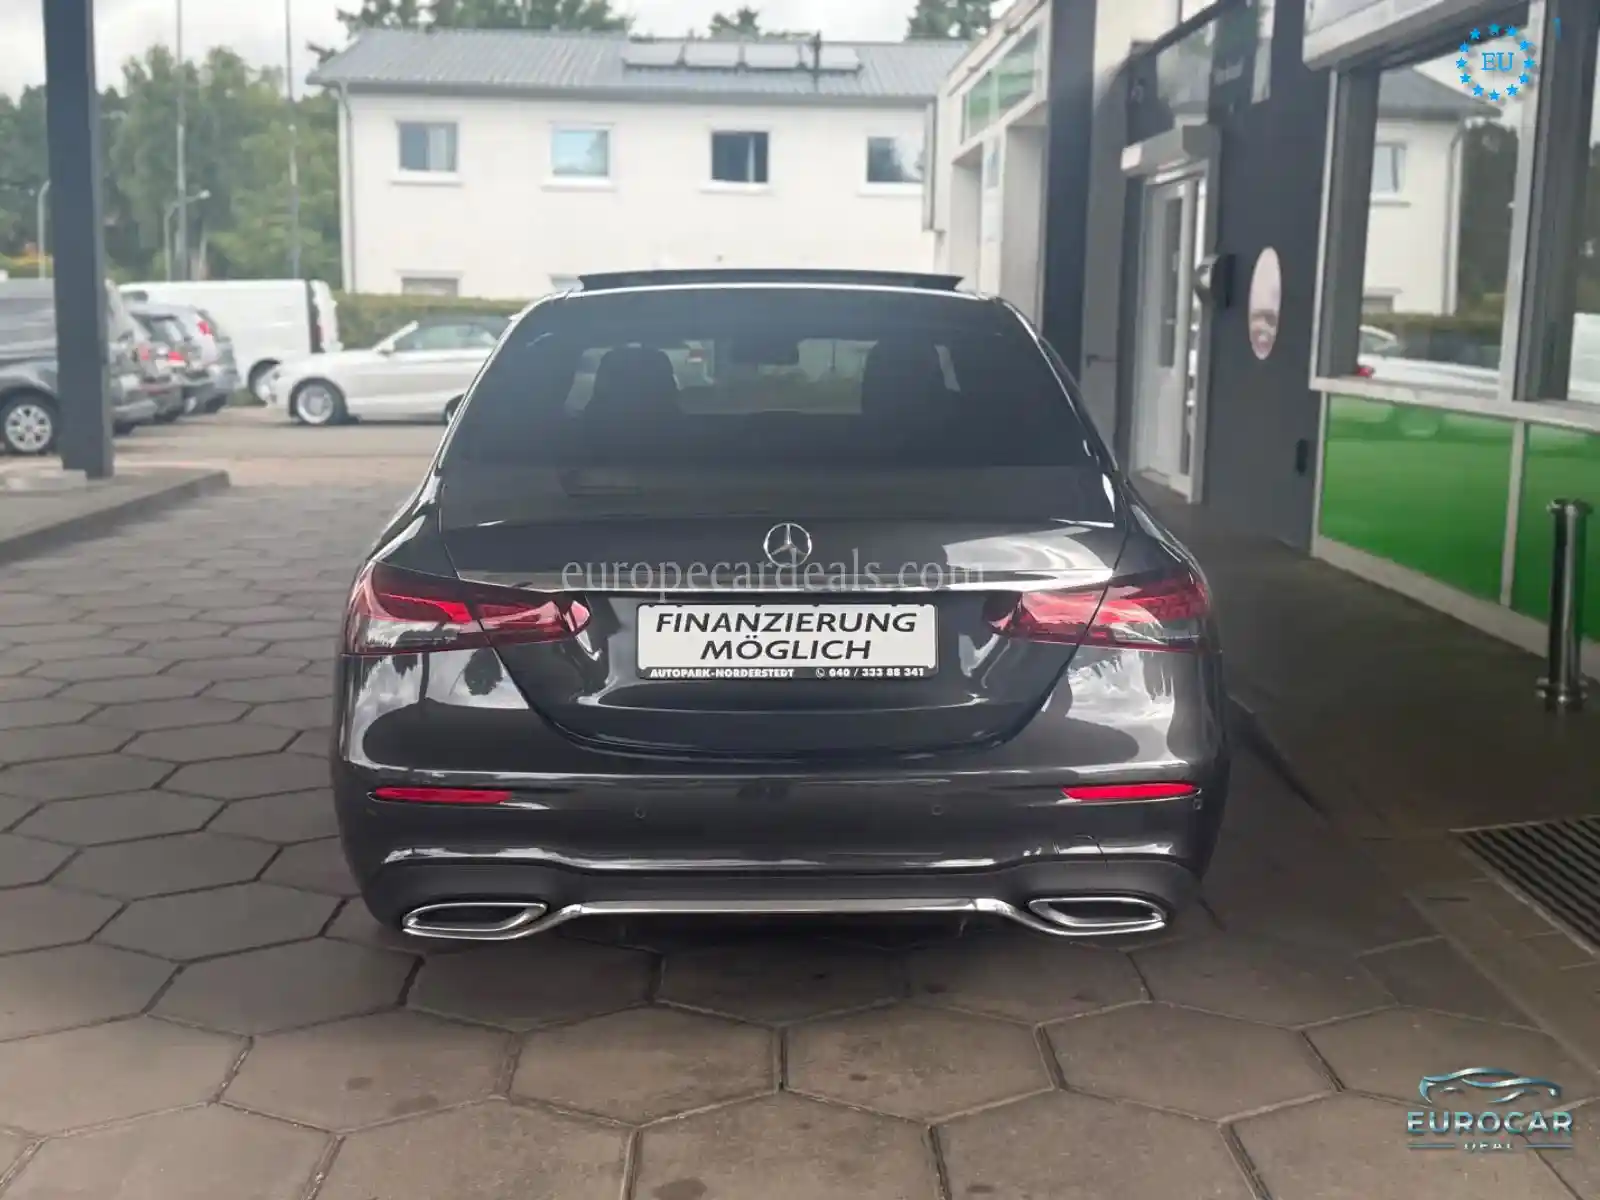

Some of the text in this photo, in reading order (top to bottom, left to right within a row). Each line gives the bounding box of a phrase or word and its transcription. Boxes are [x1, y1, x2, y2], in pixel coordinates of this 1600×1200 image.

[655, 612, 917, 633] FINANZIERUNG
[700, 635, 872, 660] MÖGLICH
[650, 668, 794, 679] AUTOPARK-NORDERSTEDT
